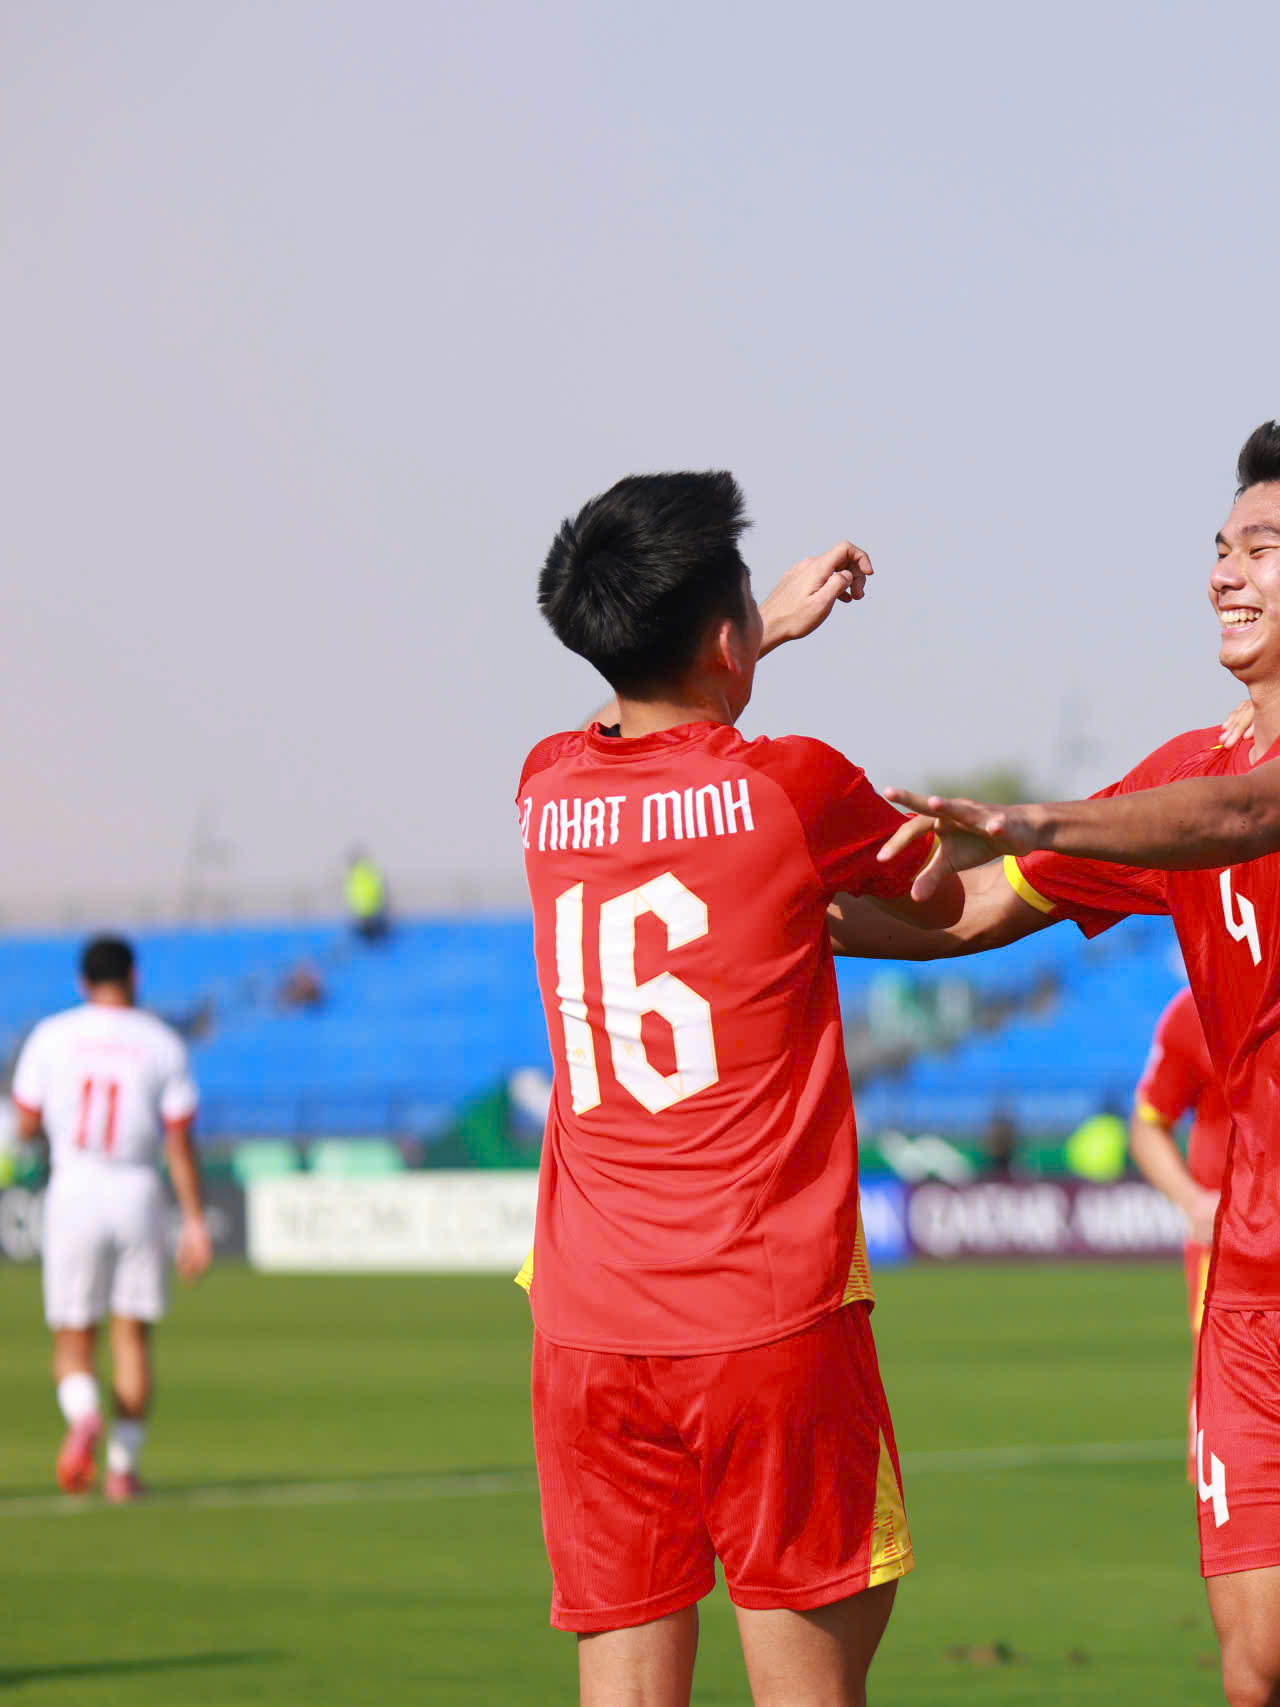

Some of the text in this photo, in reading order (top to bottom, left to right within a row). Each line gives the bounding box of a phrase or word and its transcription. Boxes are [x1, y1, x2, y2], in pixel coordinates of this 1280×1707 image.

[538, 795, 626, 851] NHAT
[642, 778, 754, 843] MINH
[1219, 867, 1262, 967] 4
[554, 870, 719, 1115] 16
[74, 1074, 120, 1153] 11
[1197, 1428, 1230, 1529] 4
